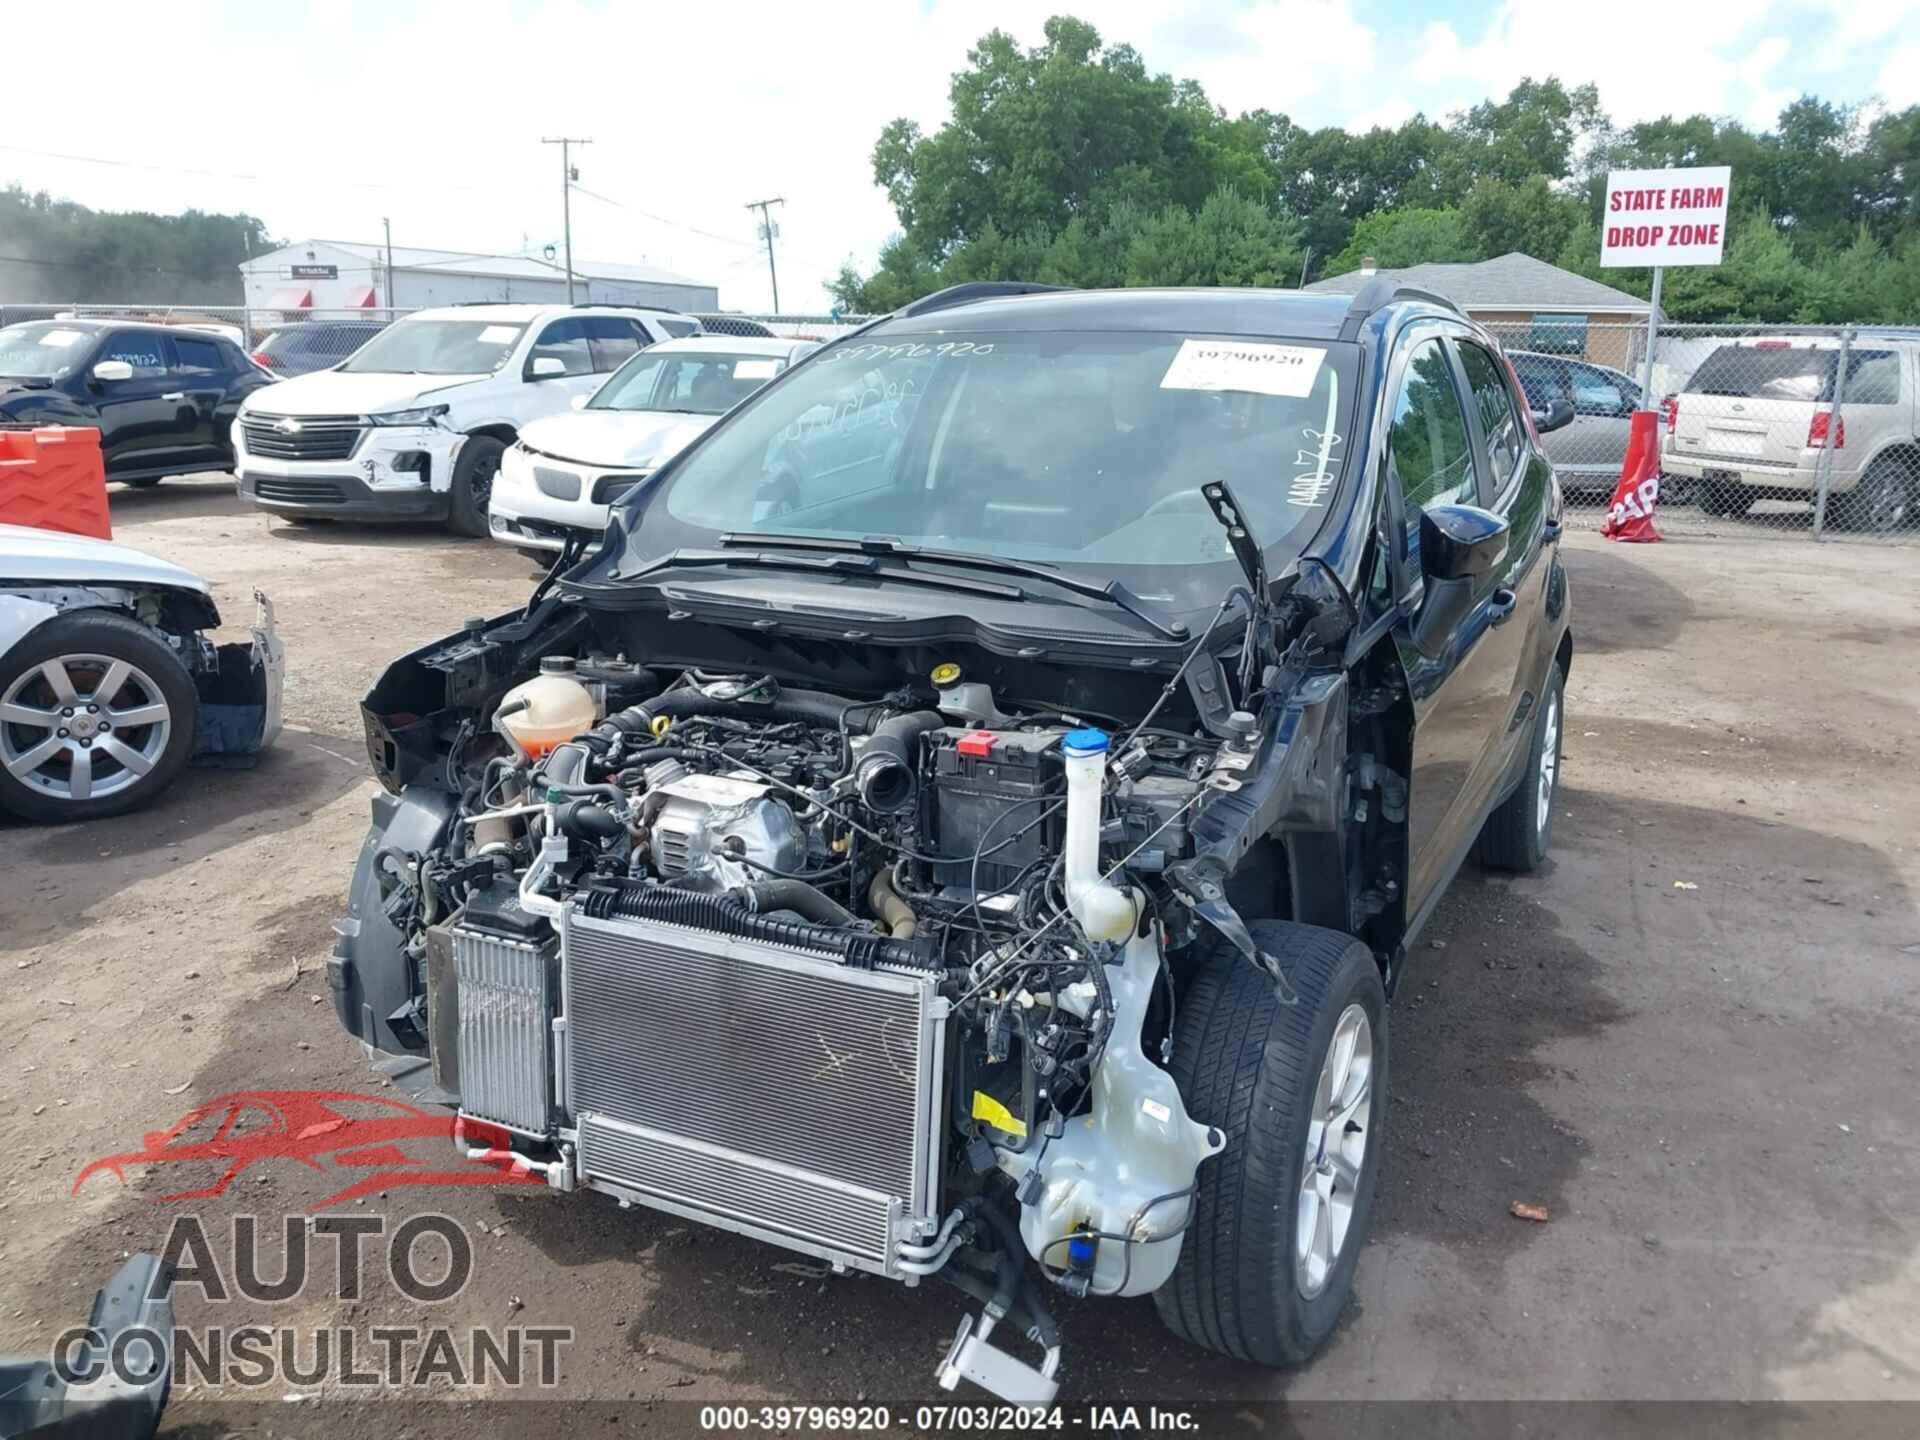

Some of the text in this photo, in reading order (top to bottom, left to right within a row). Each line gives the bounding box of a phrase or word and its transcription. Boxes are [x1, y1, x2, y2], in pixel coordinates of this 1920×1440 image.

[1610, 186, 1724, 212] STATE FARM
[1606, 223, 1720, 248] DROP ZONE
